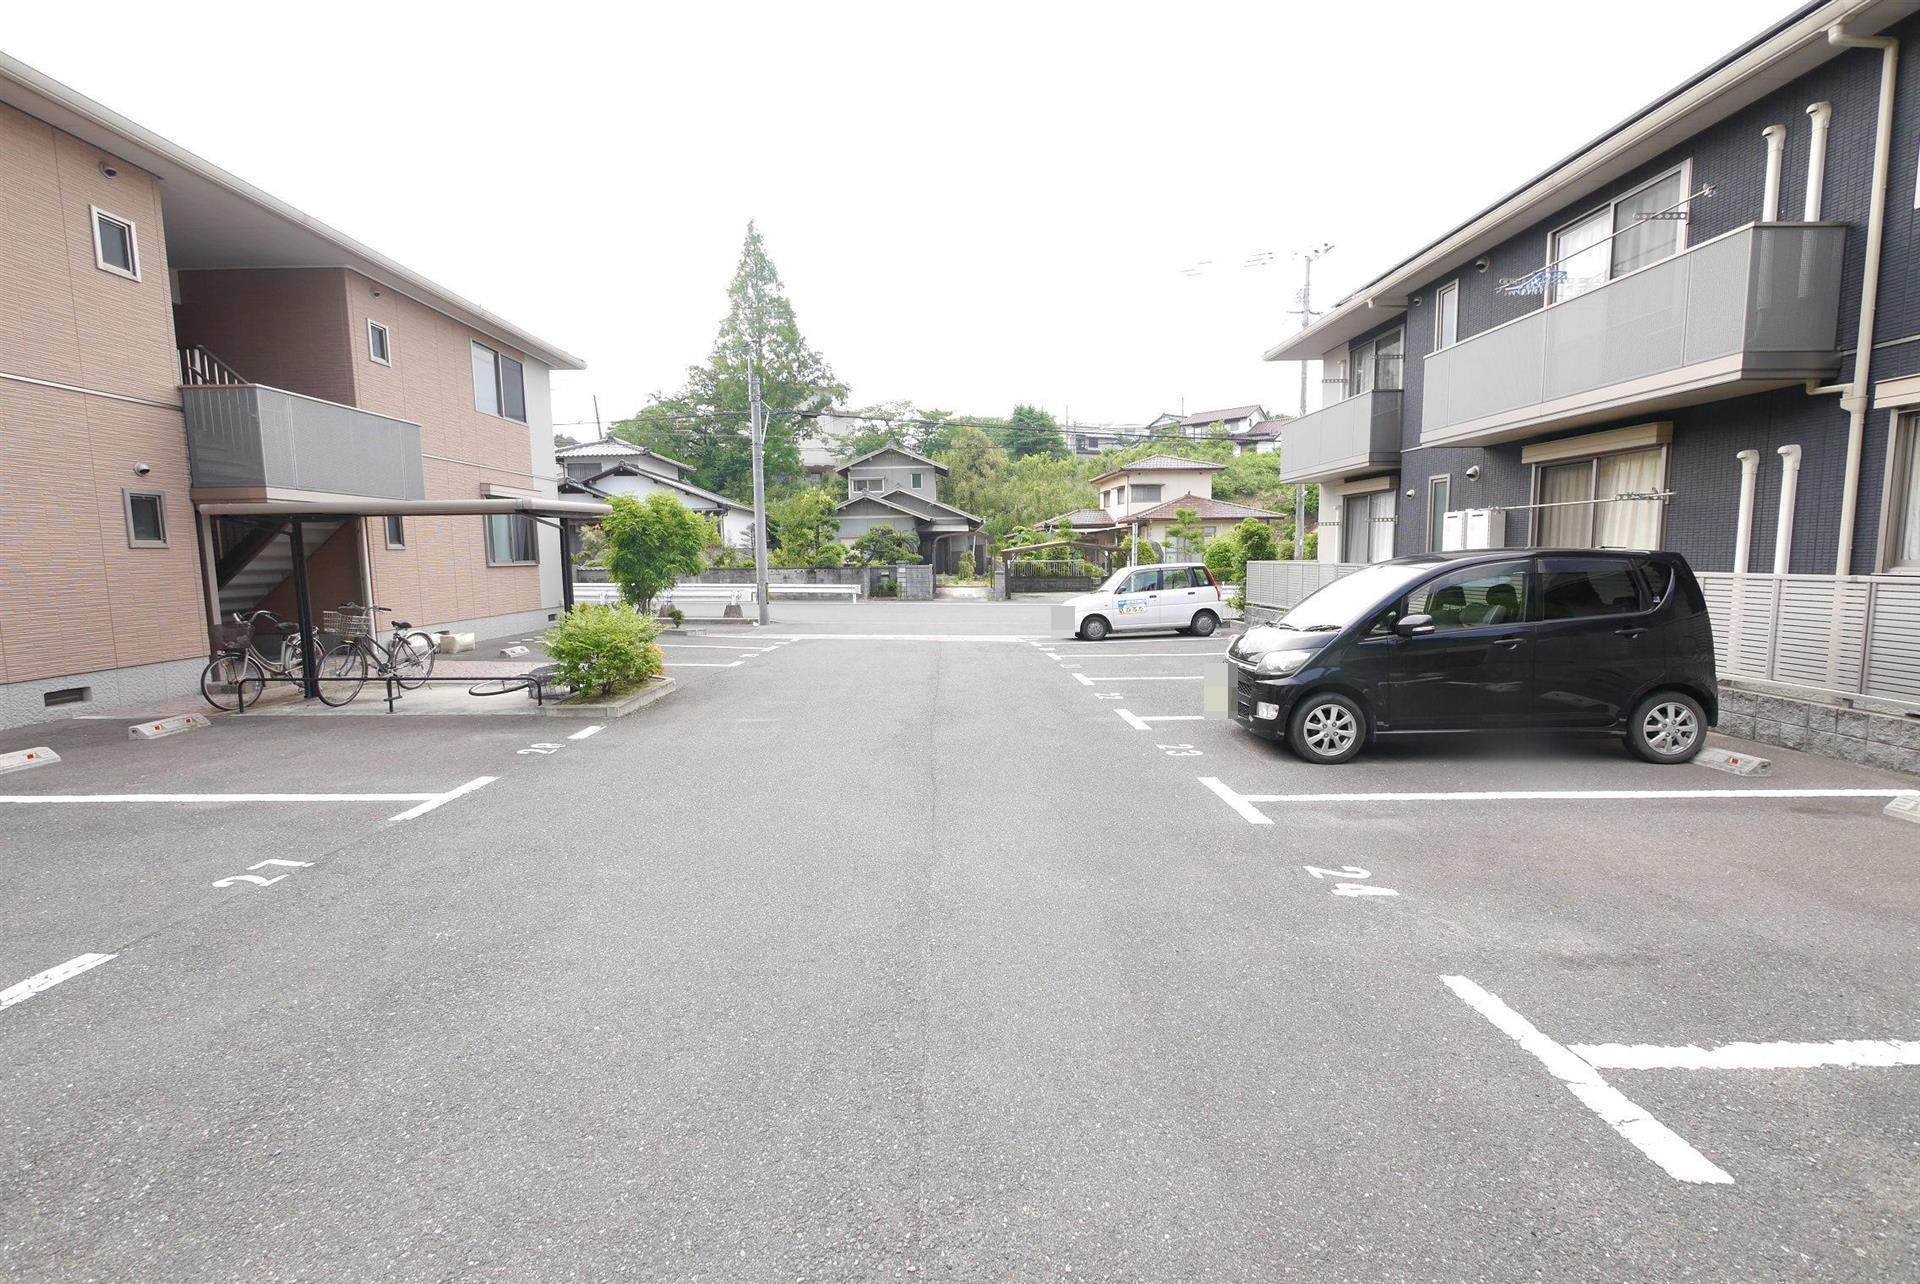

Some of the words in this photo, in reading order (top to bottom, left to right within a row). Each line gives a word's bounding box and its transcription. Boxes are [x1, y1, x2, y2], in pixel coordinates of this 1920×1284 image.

[1154, 743, 1204, 757] 23
[211, 858, 316, 888] 27
[1302, 865, 1400, 897] 24
